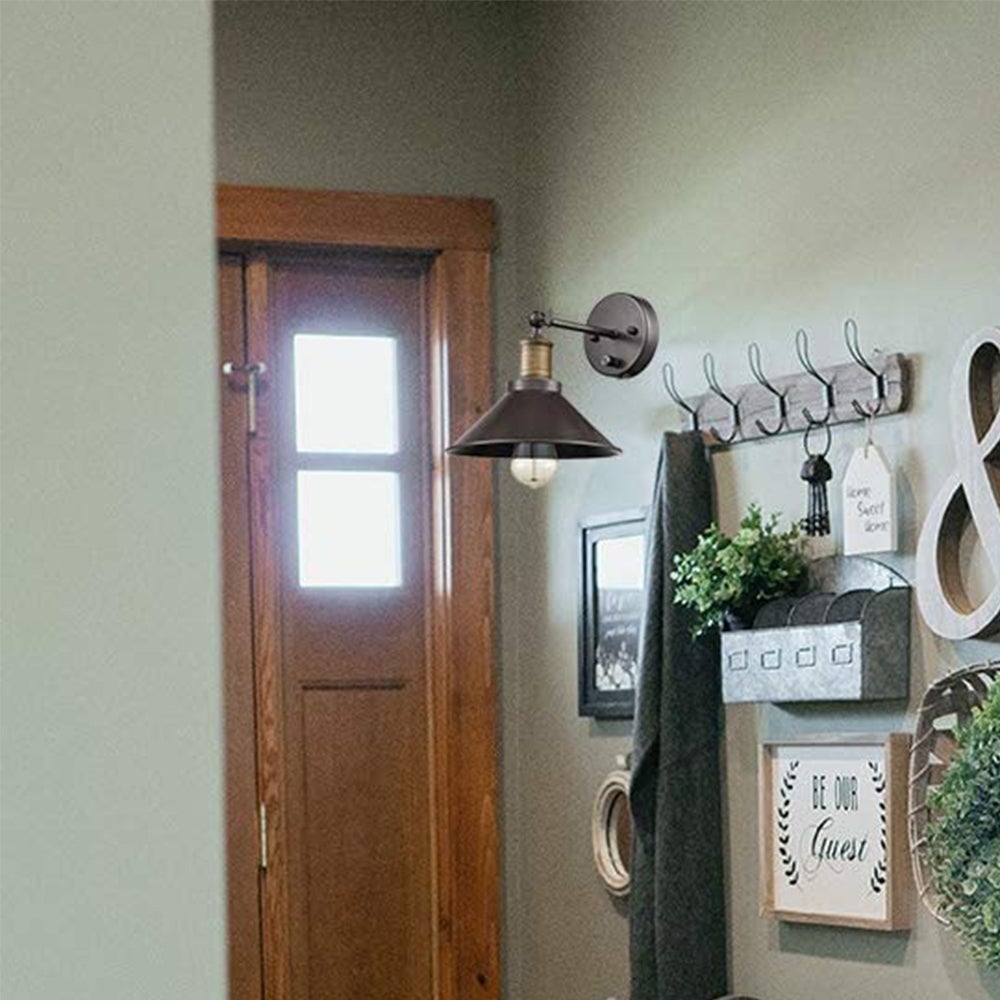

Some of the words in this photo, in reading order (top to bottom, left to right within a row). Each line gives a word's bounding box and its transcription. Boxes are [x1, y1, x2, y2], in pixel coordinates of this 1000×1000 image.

[813, 775, 827, 810] BE
[835, 775, 859, 812] OUR
[801, 816, 869, 881] Guest
